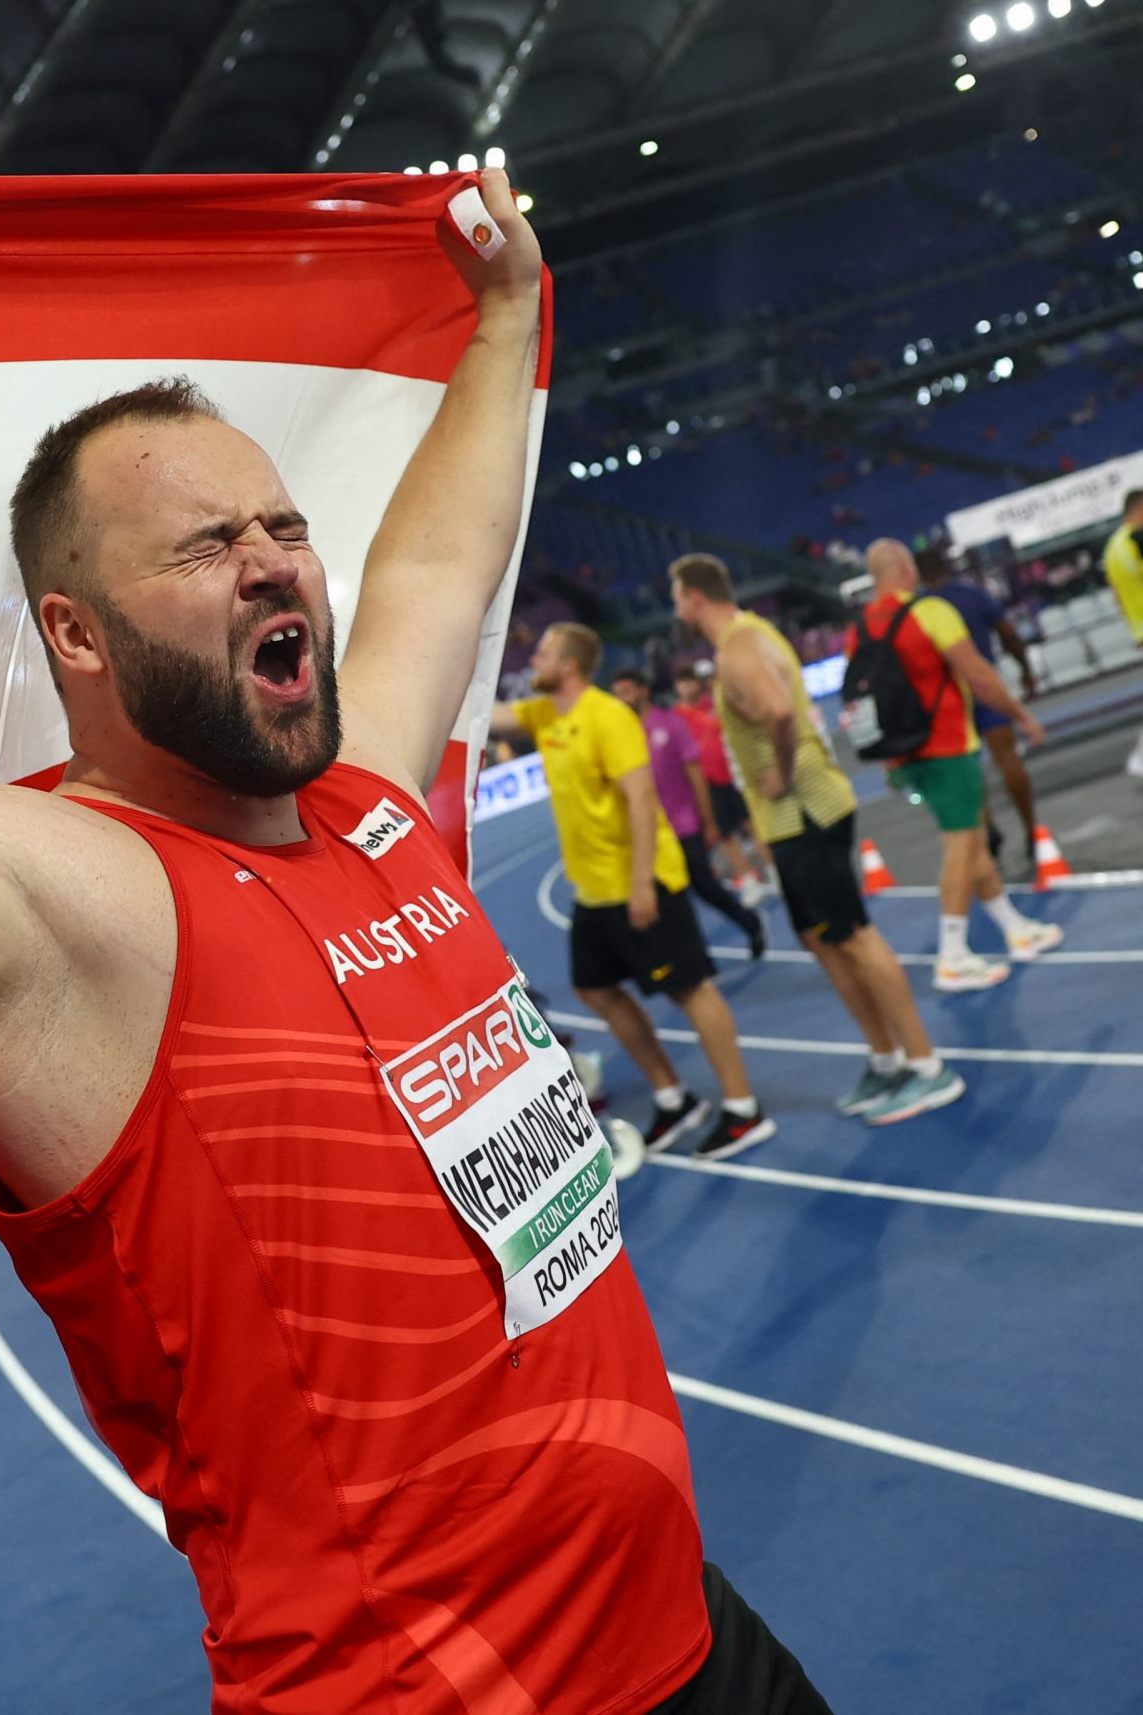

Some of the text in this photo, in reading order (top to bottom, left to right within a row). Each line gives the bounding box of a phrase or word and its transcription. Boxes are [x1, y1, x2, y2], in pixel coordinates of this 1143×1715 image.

[323, 886, 470, 985] AUSTRIA
[400, 1009, 521, 1123] SPAR
[528, 1226, 539, 1249] I
[535, 1201, 567, 1243] RUN
[533, 1231, 598, 1307] ROMA
